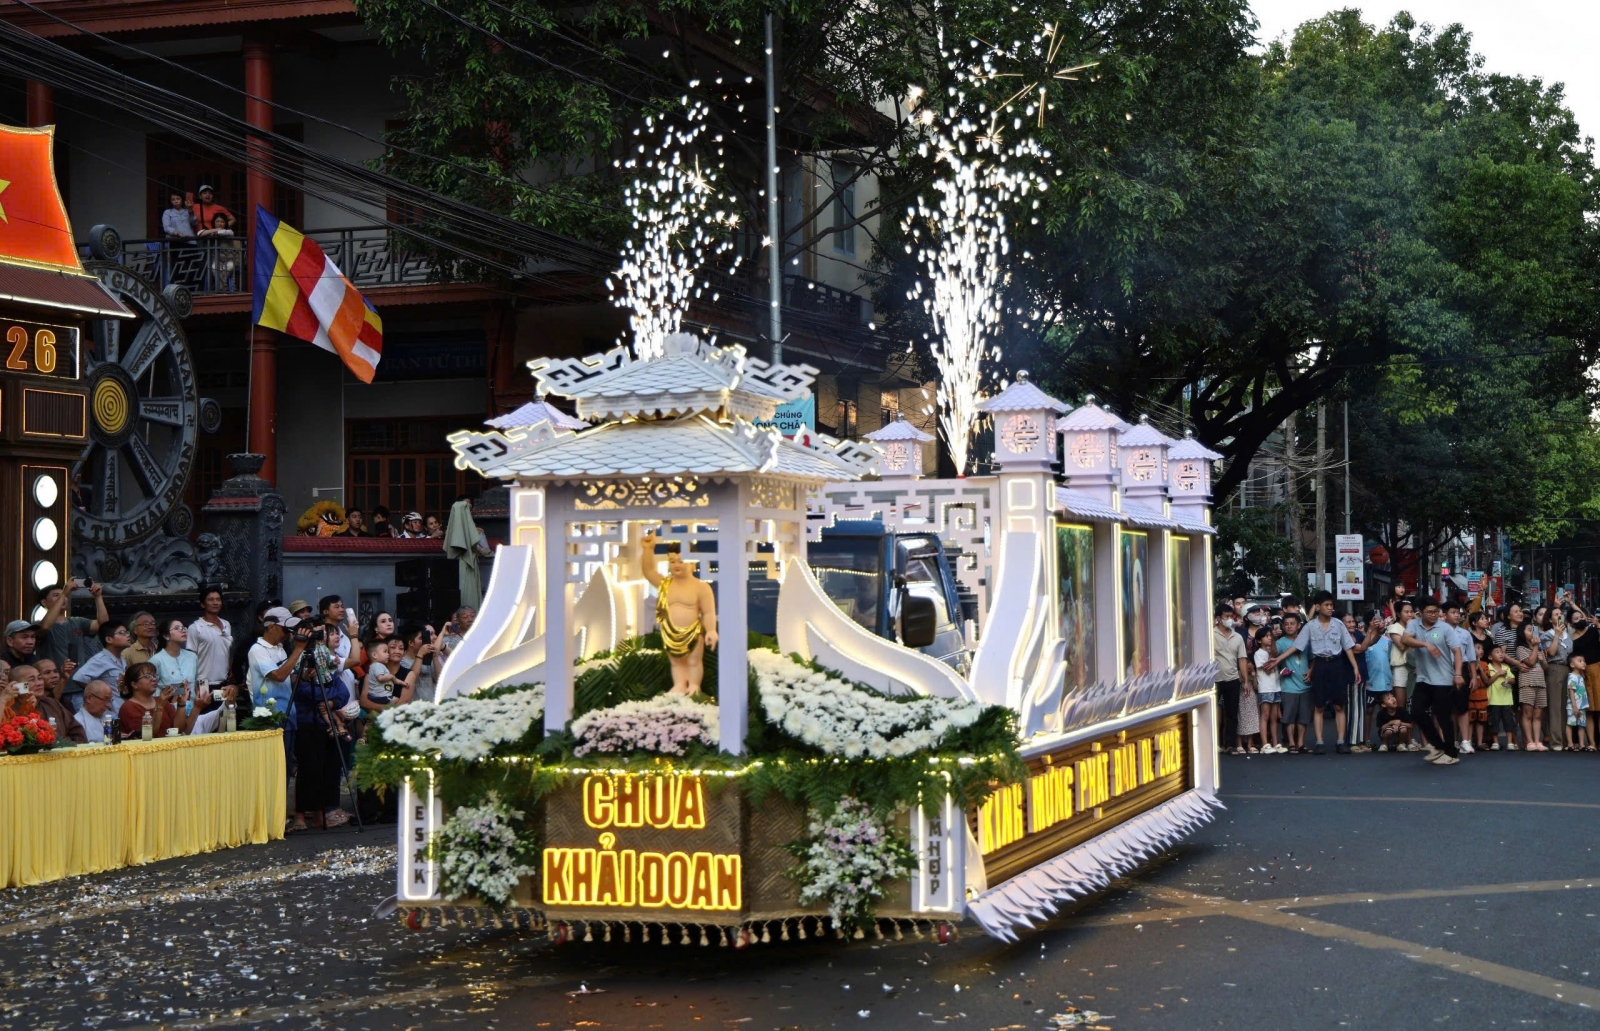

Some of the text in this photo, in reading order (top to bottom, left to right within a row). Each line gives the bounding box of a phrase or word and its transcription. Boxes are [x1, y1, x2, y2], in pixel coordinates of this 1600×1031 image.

[7, 326, 56, 373] 26
[177, 349, 196, 402] NAM
[543, 831, 636, 906] KHẢI
